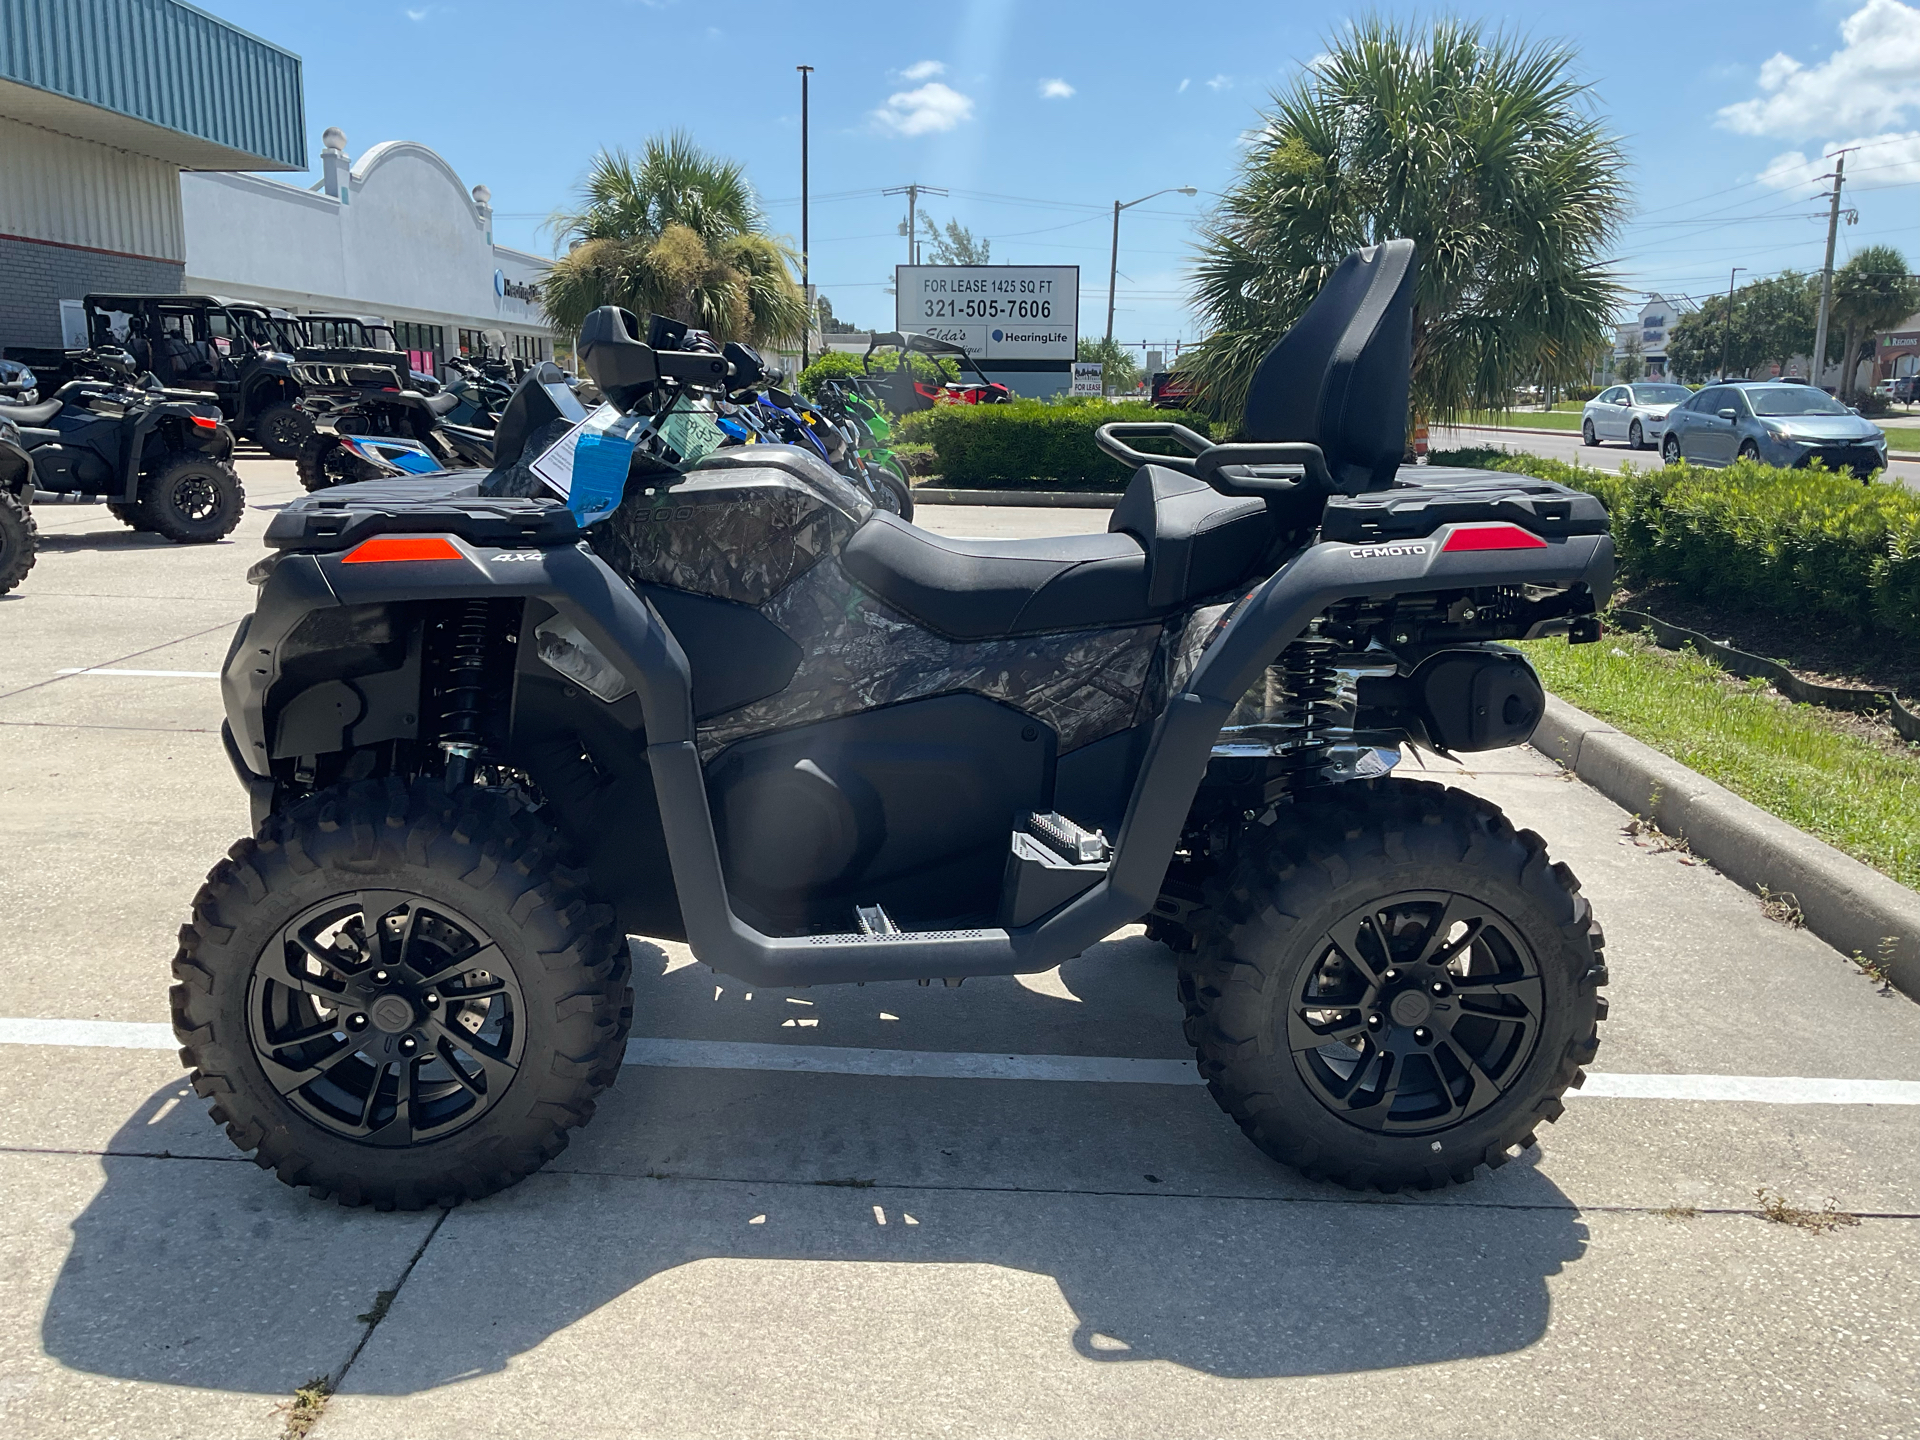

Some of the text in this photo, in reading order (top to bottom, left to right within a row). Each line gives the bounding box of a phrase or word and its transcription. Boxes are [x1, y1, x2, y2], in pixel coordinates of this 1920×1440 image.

[924, 279, 1053, 294] FOR LEASE 1425 SQ FT
[924, 299, 1051, 318] 321-505-7606
[925, 327, 967, 341] Elda's
[1005, 332, 1068, 344] HearingLife
[1075, 383, 1102, 391] FOR LEASE
[634, 507, 694, 523] 800
[1349, 546, 1427, 559] CFMOTO
